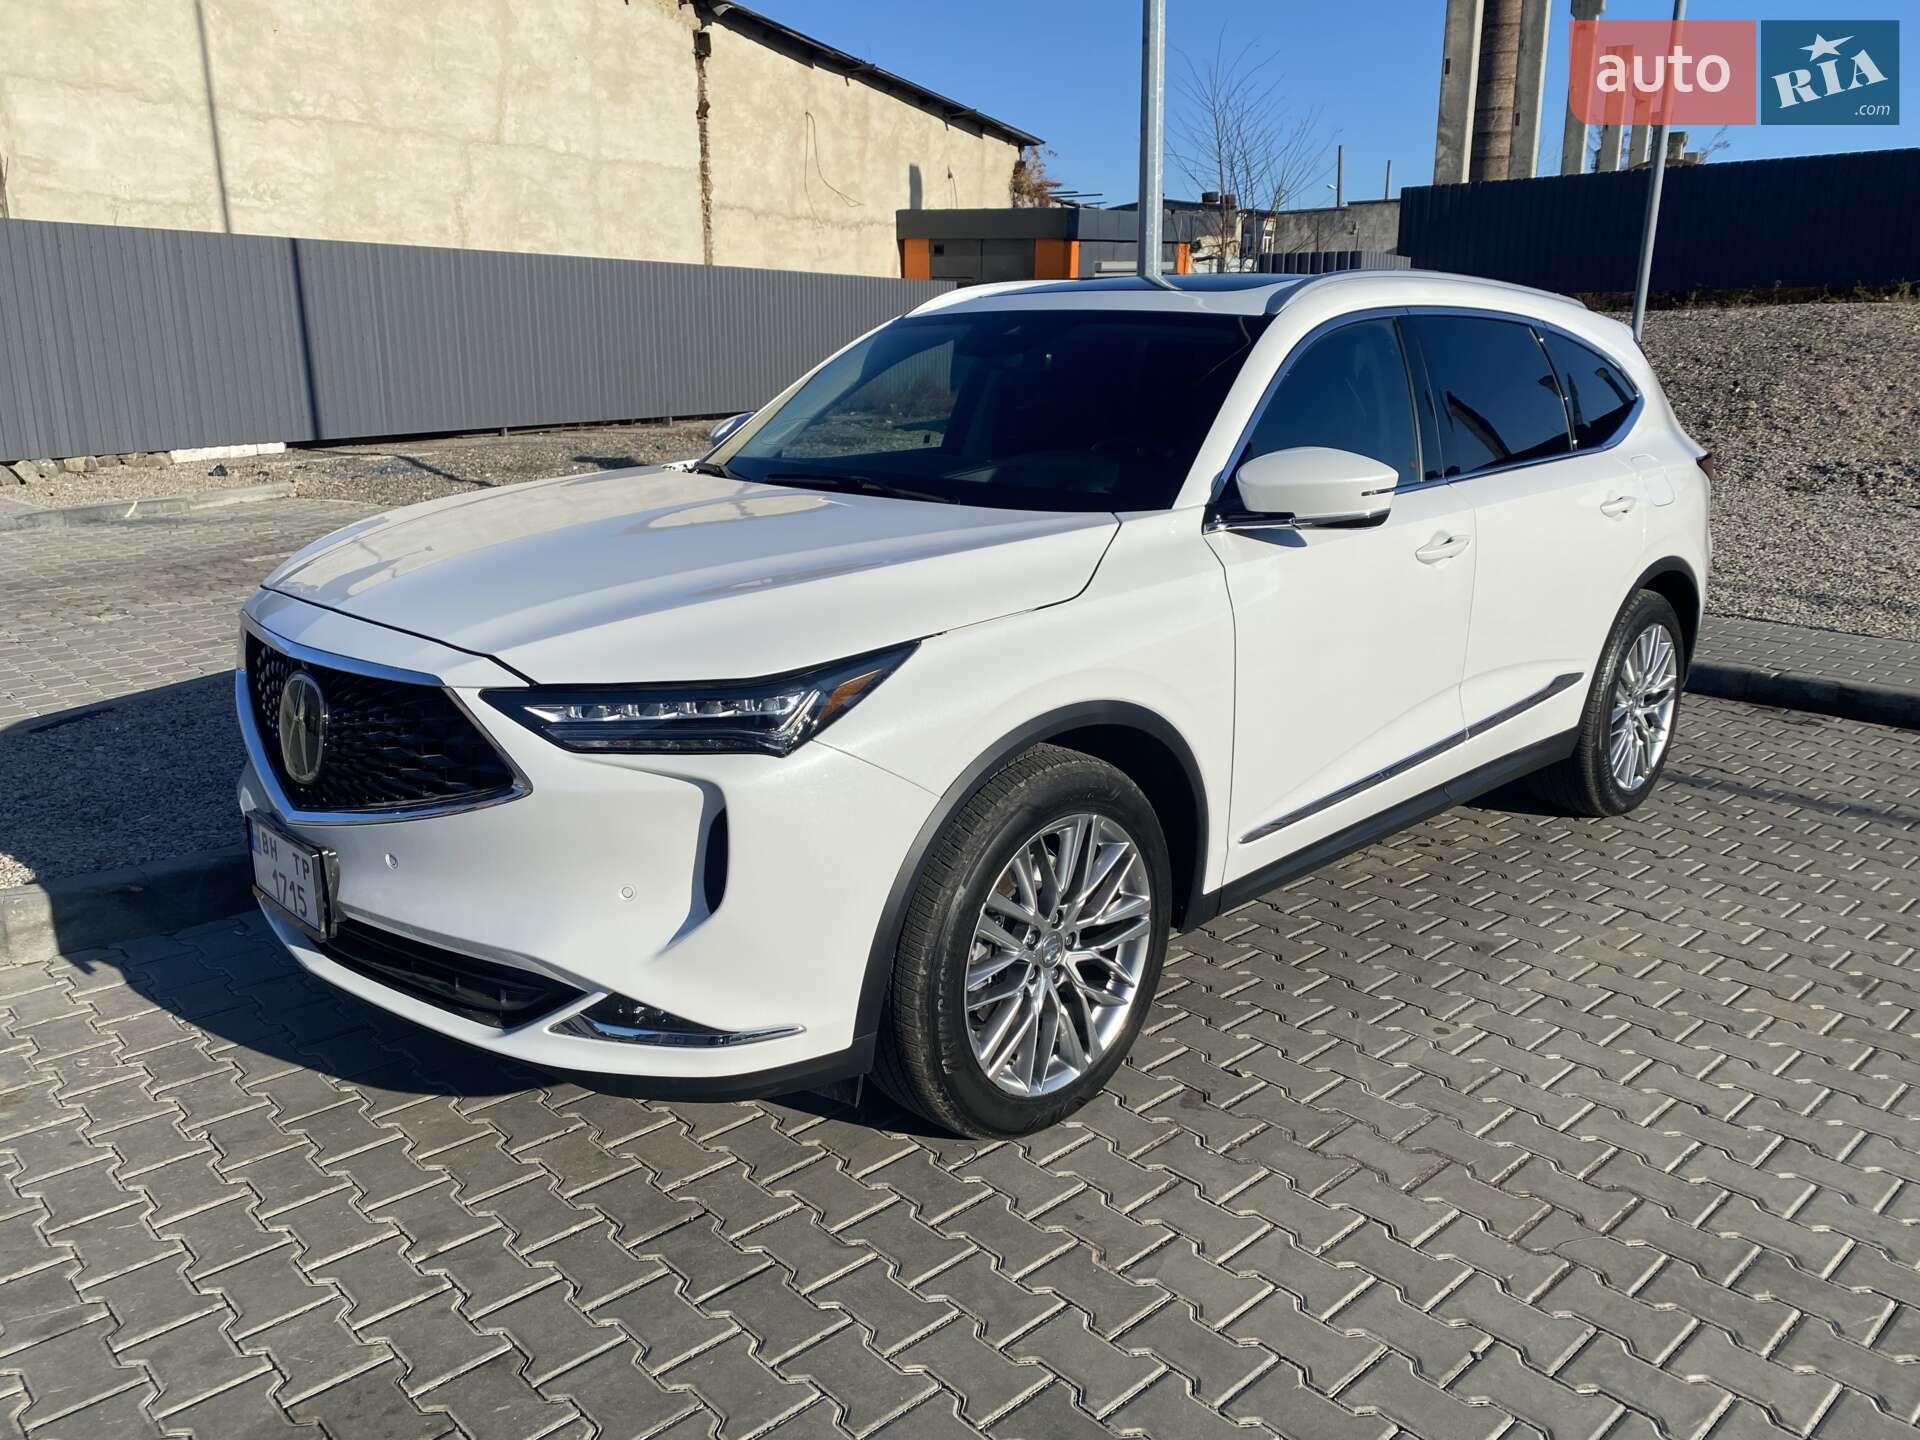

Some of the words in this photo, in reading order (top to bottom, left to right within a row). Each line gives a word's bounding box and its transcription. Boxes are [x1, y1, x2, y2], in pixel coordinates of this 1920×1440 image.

[261, 831, 278, 862] BH
[292, 852, 310, 881] TP
[272, 869, 307, 918] 1715
